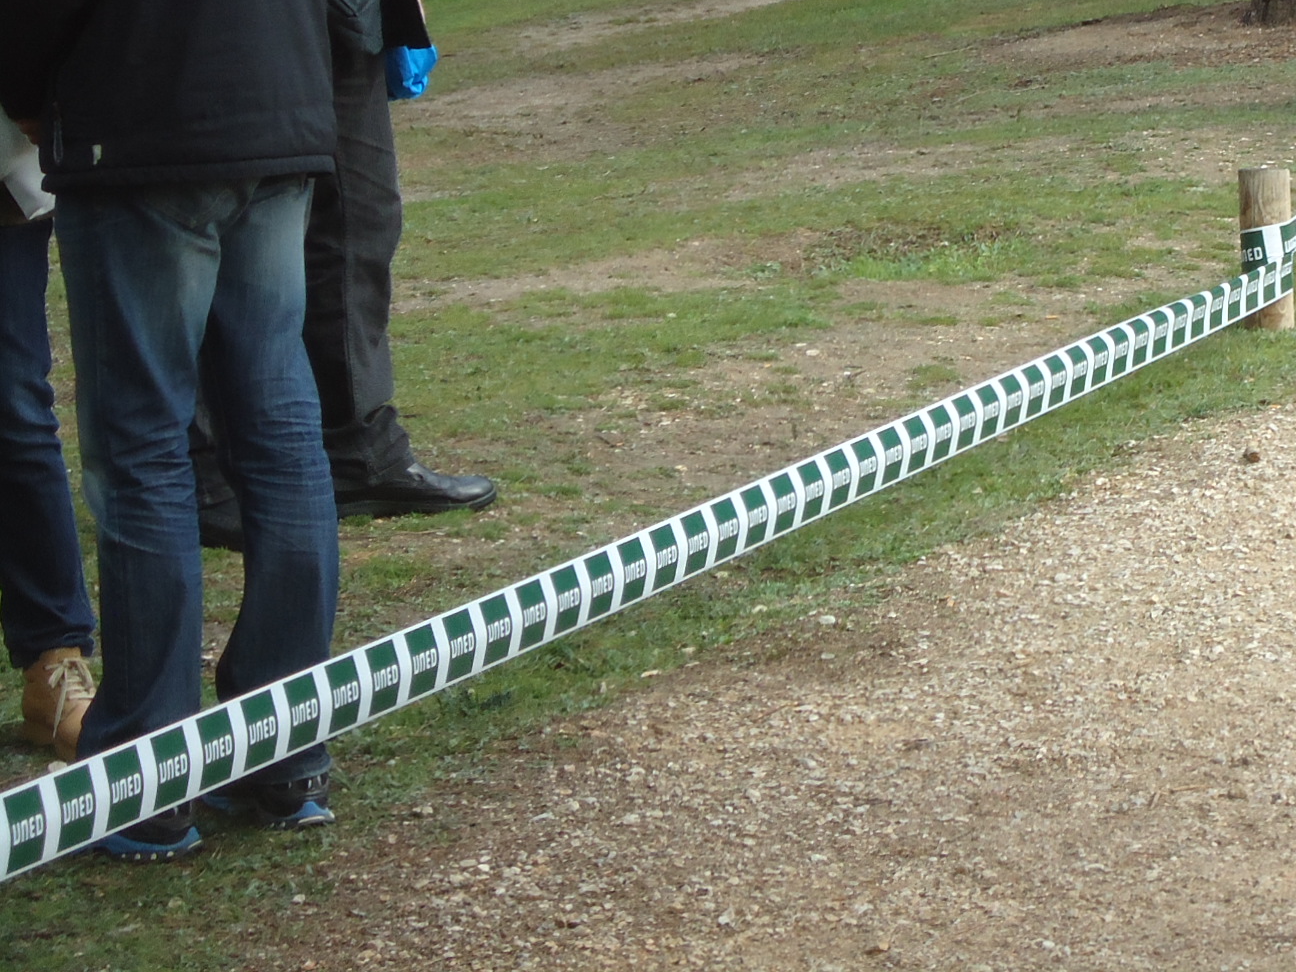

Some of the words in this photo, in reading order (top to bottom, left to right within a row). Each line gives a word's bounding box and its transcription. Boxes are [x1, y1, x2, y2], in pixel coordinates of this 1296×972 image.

[1241, 246, 1263, 263] NED
[12, 813, 44, 845] UNED
[63, 792, 93, 825] UNED
[111, 772, 142, 803] UNED
[158, 753, 188, 784] UNED
[204, 734, 233, 764] UNED
[248, 715, 276, 744] UNED
[291, 698, 318, 726] UNED
[333, 681, 359, 709] UNED
[373, 664, 398, 692] UNED
[412, 648, 437, 675] UNED
[450, 632, 475, 659] UNED
[487, 617, 511, 643] UNED
[523, 601, 546, 627] UNED
[558, 587, 581, 612] UNED
[591, 573, 613, 599] UNED
[624, 558, 646, 584] UNED
[656, 544, 677, 569] UNED
[687, 530, 708, 555] UNED
[718, 517, 739, 542] UNED
[748, 504, 768, 528] UNED
[777, 491, 796, 515] UNED
